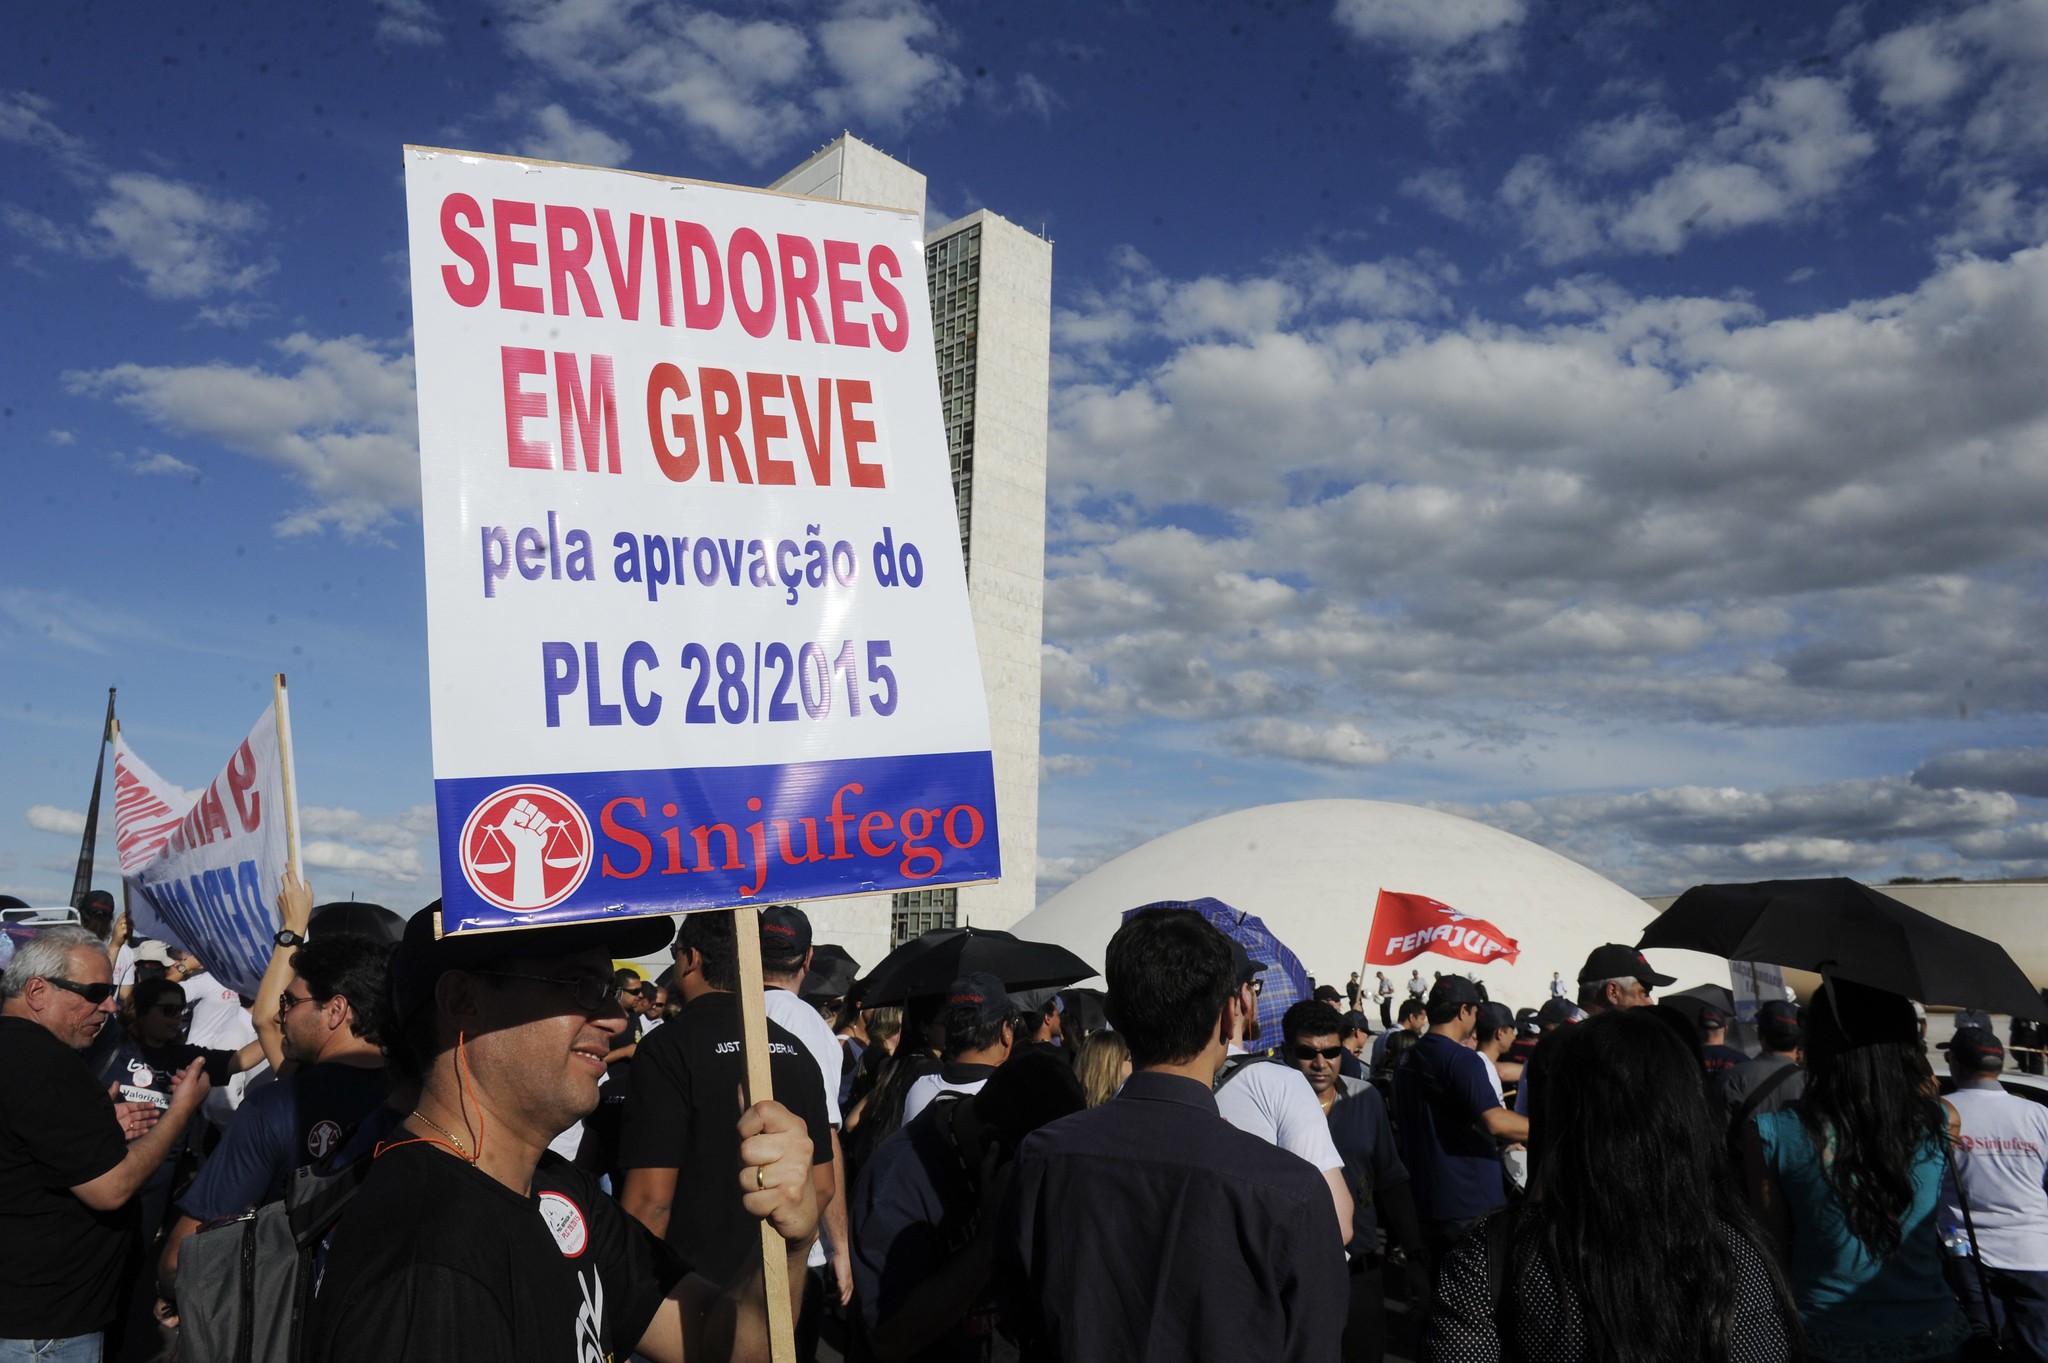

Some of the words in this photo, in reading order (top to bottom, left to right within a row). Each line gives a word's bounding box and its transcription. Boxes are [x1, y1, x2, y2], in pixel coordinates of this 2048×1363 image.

[440, 192, 909, 353] SERVIDORES
[501, 345, 622, 475] EM
[647, 362, 886, 490] GREVE
[481, 510, 596, 598] pela
[613, 524, 859, 606] aprovação
[873, 527, 924, 588] do
[542, 640, 662, 728] PLC
[680, 640, 899, 725] 28/2015
[600, 782, 985, 897] Sinjufego
